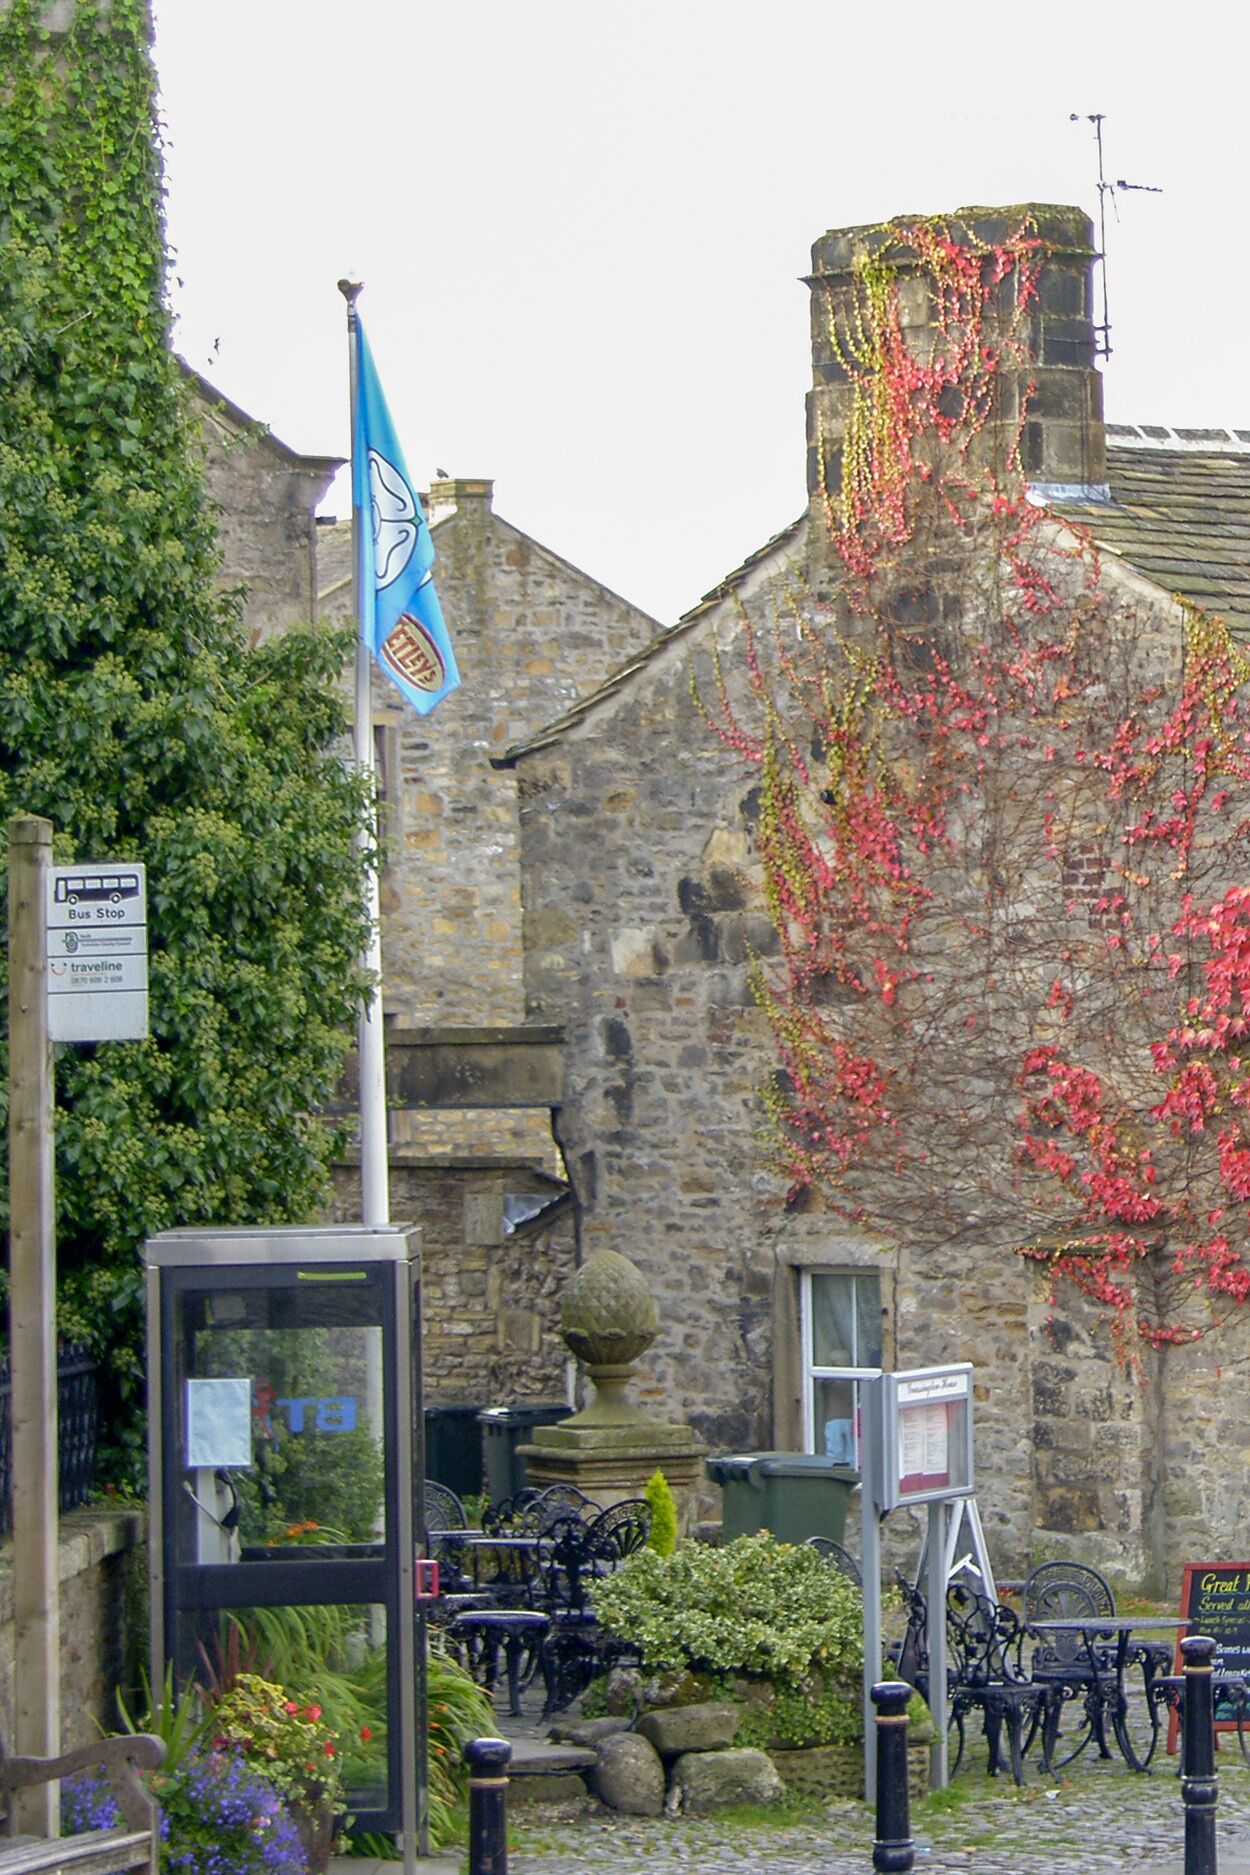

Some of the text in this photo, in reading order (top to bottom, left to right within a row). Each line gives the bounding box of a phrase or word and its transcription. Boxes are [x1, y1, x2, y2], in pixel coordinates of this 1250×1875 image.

[69, 908, 126, 920] Bus Stop
[71, 961, 123, 972] traveline
[1201, 1573, 1240, 1593] Great
[1198, 1596, 1235, 1611] Served
